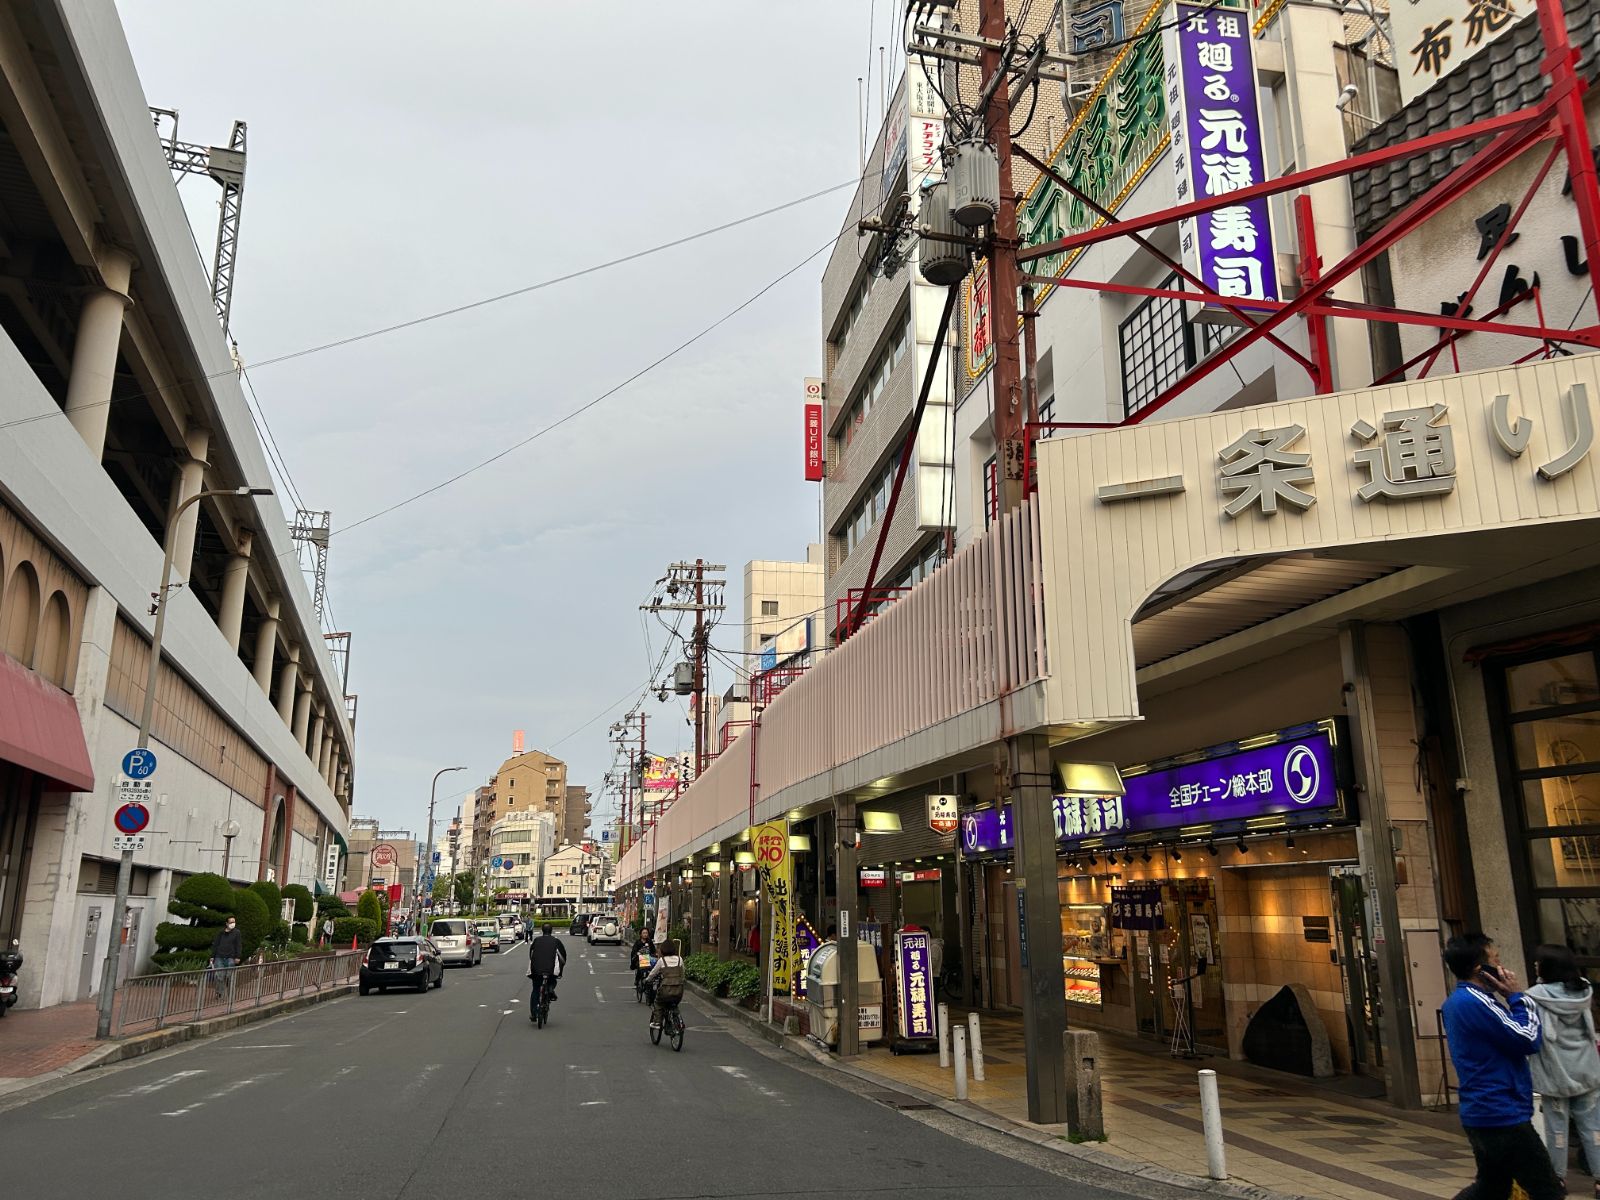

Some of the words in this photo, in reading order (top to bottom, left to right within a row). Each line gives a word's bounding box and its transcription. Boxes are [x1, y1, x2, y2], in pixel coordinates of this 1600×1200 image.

[1186, 10, 1241, 38] 元祖
[1197, 42, 1232, 101] 廻る
[922, 122, 934, 165] アデランス
[1199, 109, 1263, 301] 元禄寿司
[809, 411, 819, 467] 三菱UFJ銀行
[1098, 383, 1597, 518] 一条通り
[129, 756, 144, 774] P
[138, 766, 149, 775] 60
[1169, 768, 1274, 808] 全国チェーン総本部
[903, 937, 926, 949] 元祖
[910, 971, 928, 1034] 元禄寿司
